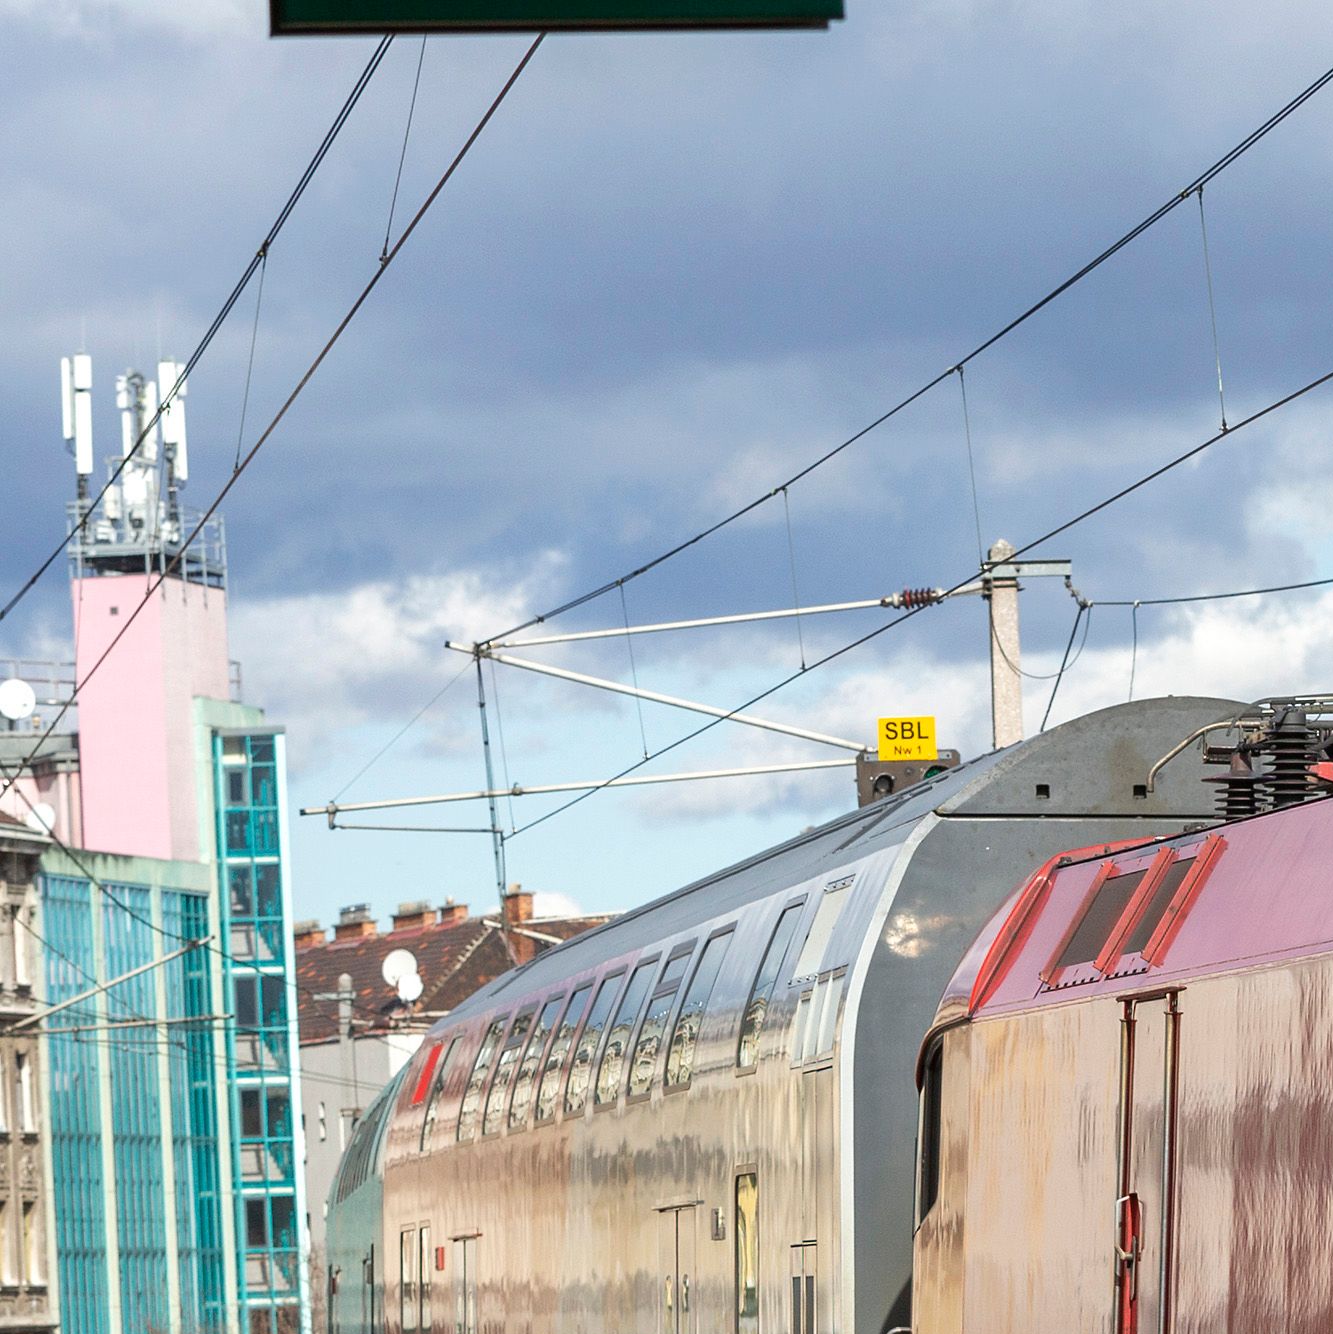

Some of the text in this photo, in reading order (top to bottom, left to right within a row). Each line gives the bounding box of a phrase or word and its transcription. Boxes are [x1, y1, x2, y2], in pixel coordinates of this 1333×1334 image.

[885, 721, 929, 740] SBL
[894, 745, 922, 755] Nw 1
